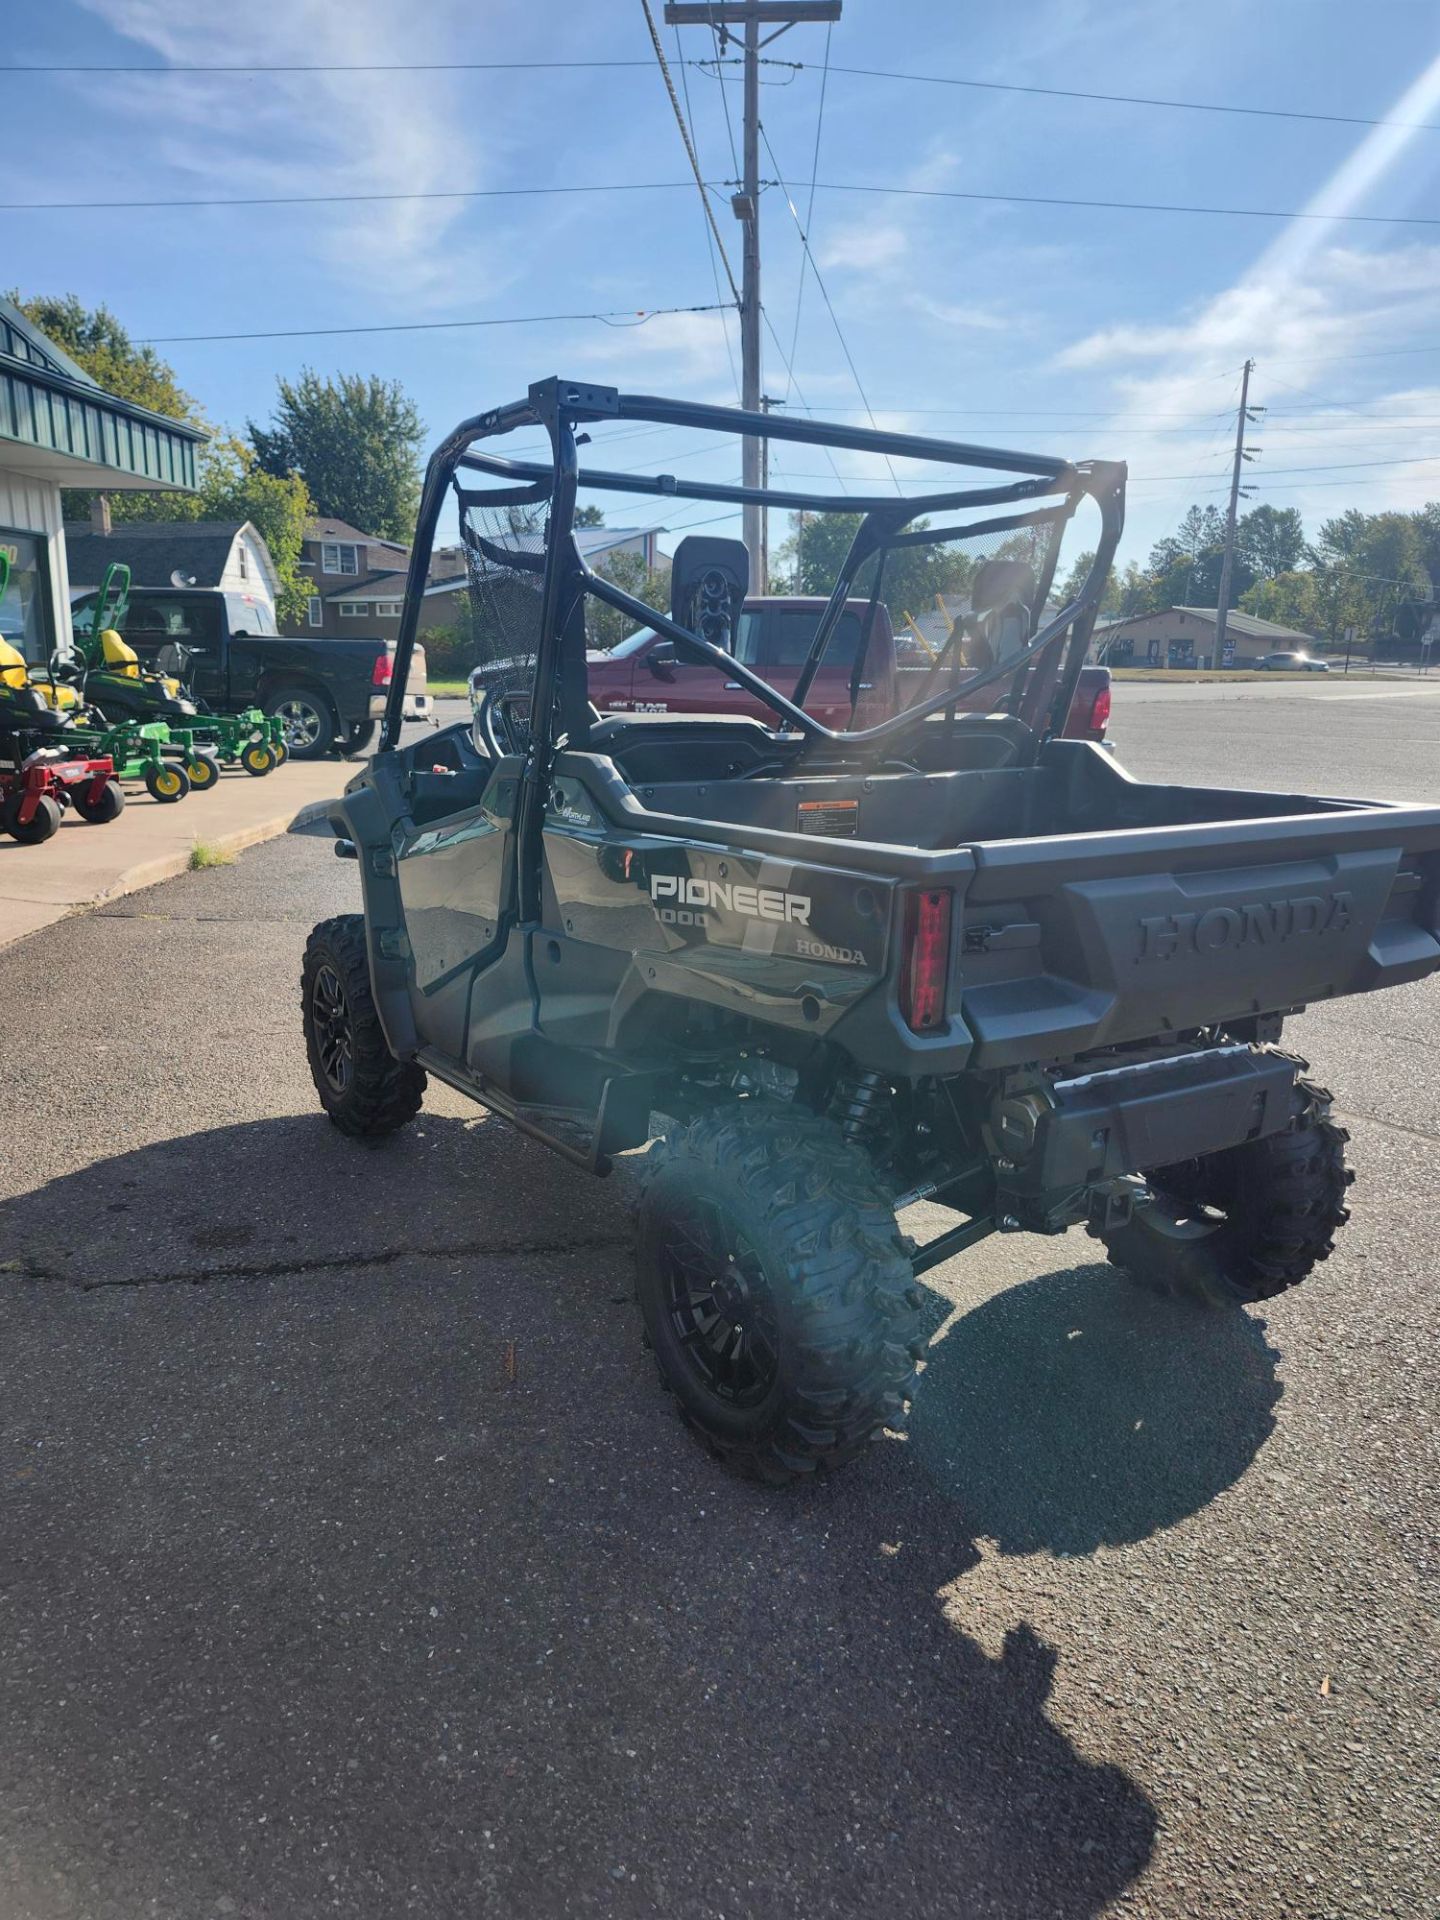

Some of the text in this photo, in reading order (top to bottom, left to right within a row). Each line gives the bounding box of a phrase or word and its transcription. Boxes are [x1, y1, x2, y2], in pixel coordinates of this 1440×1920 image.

[651, 874, 812, 926] PIONEER
[653, 907, 709, 928] 1000
[1134, 891, 1361, 965] HONDA
[796, 938, 868, 967] HONDA
